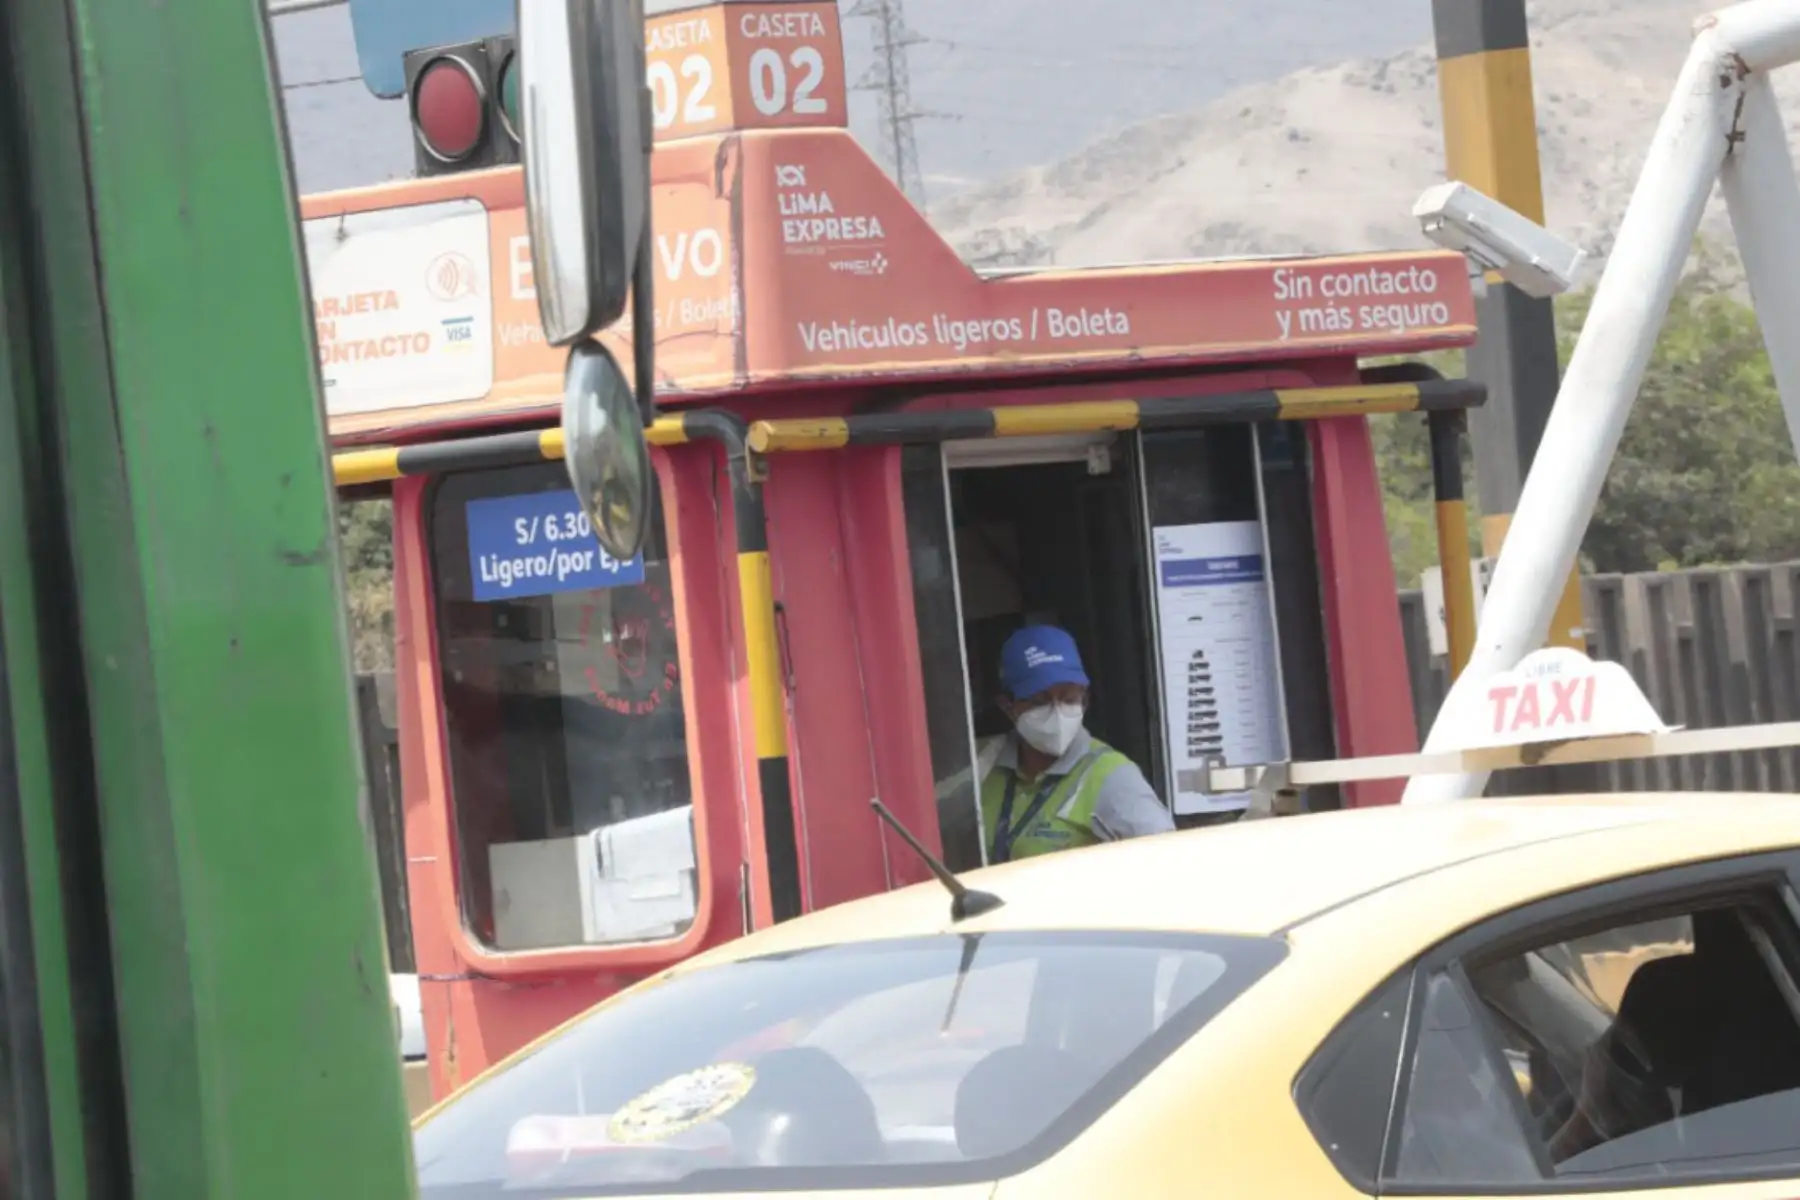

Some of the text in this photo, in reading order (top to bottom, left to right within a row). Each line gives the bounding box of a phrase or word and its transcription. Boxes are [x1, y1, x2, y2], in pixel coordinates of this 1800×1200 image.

[645, 18, 712, 52] ASETA
[740, 12, 826, 38] CASETA
[646, 54, 717, 130] 02
[749, 46, 828, 116] 02
[782, 217, 885, 243] EXPRESA
[1273, 265, 1437, 300] Sin contacto
[446, 326, 472, 341] VISA
[932, 312, 1023, 350] ligeros
[1031, 307, 1038, 341] /
[1046, 306, 1130, 338] Boleta
[1276, 299, 1448, 341] y más seguro
[319, 331, 431, 366] ONTACTO
[515, 511, 591, 546] S/ 6.30
[480, 547, 594, 588] Ligero/por
[1488, 676, 1596, 733] TAXI
